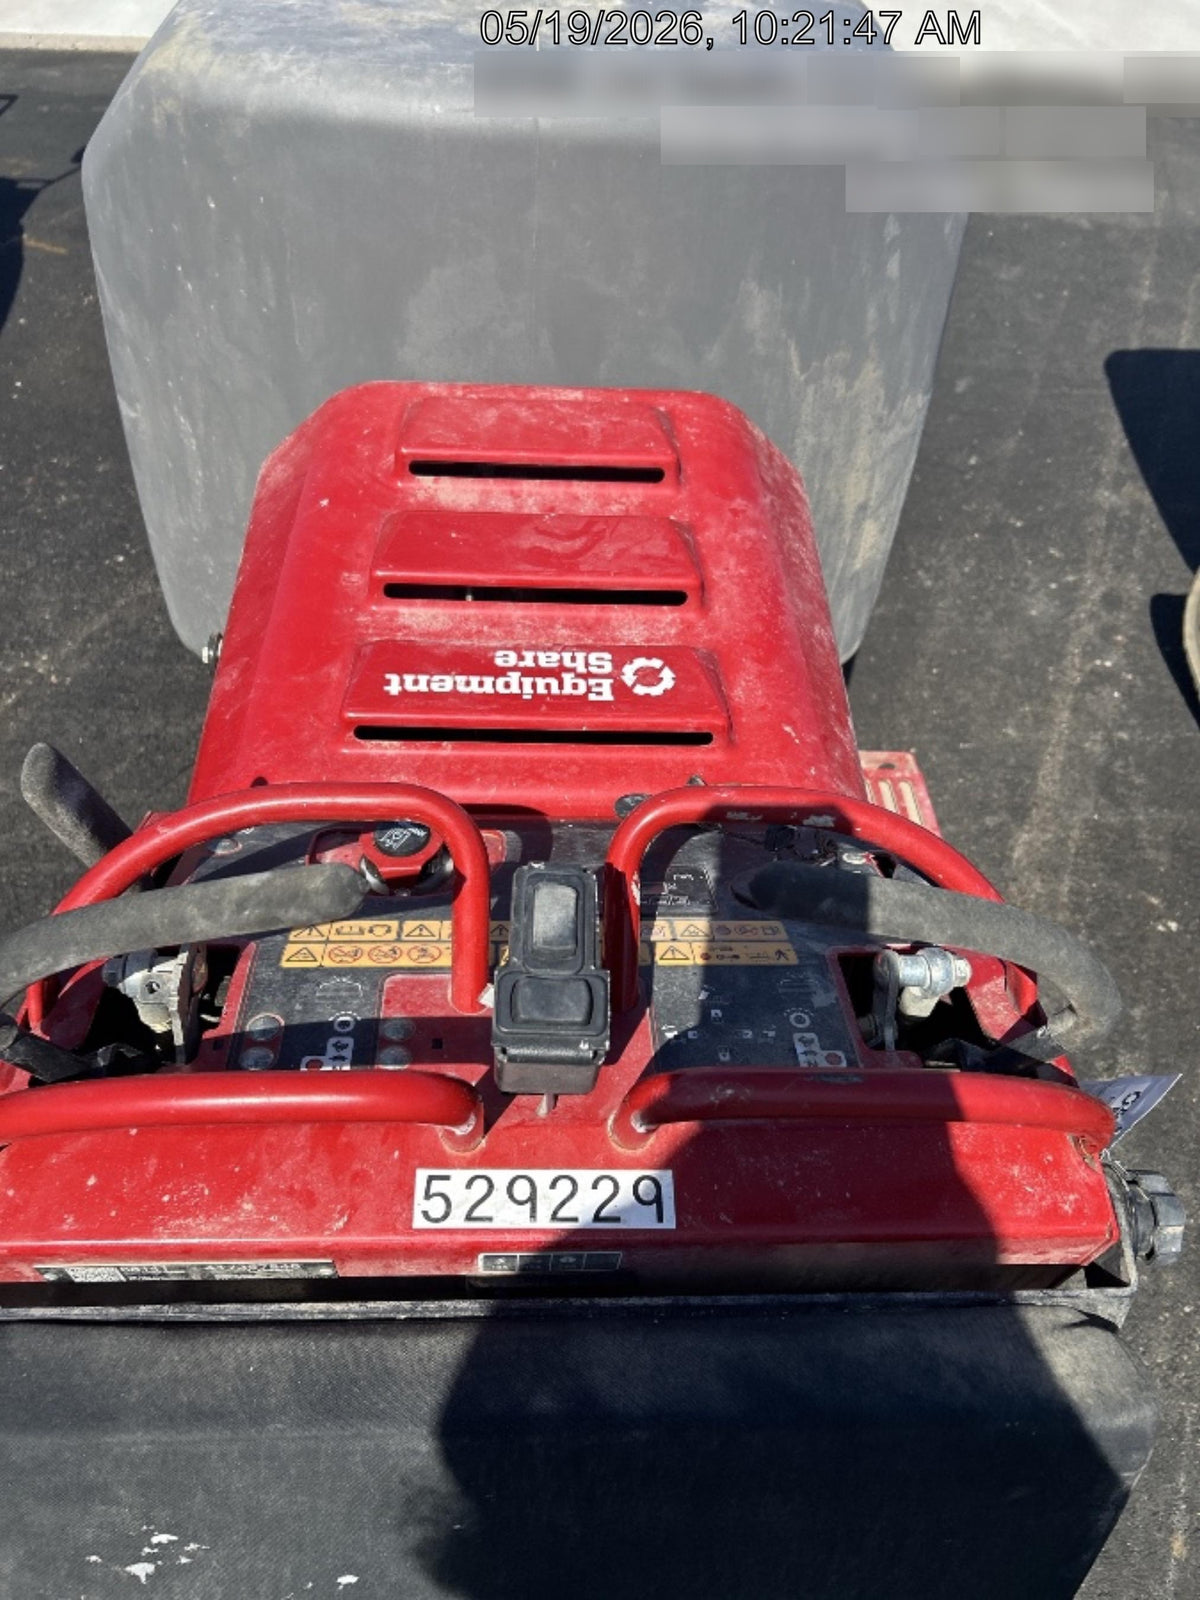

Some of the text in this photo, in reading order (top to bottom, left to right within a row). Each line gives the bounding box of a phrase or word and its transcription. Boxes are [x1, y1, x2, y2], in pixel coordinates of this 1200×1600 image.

[494, 650, 612, 674] Share
[384, 671, 614, 701] Equipment
[421, 1174, 664, 1224] 529229
